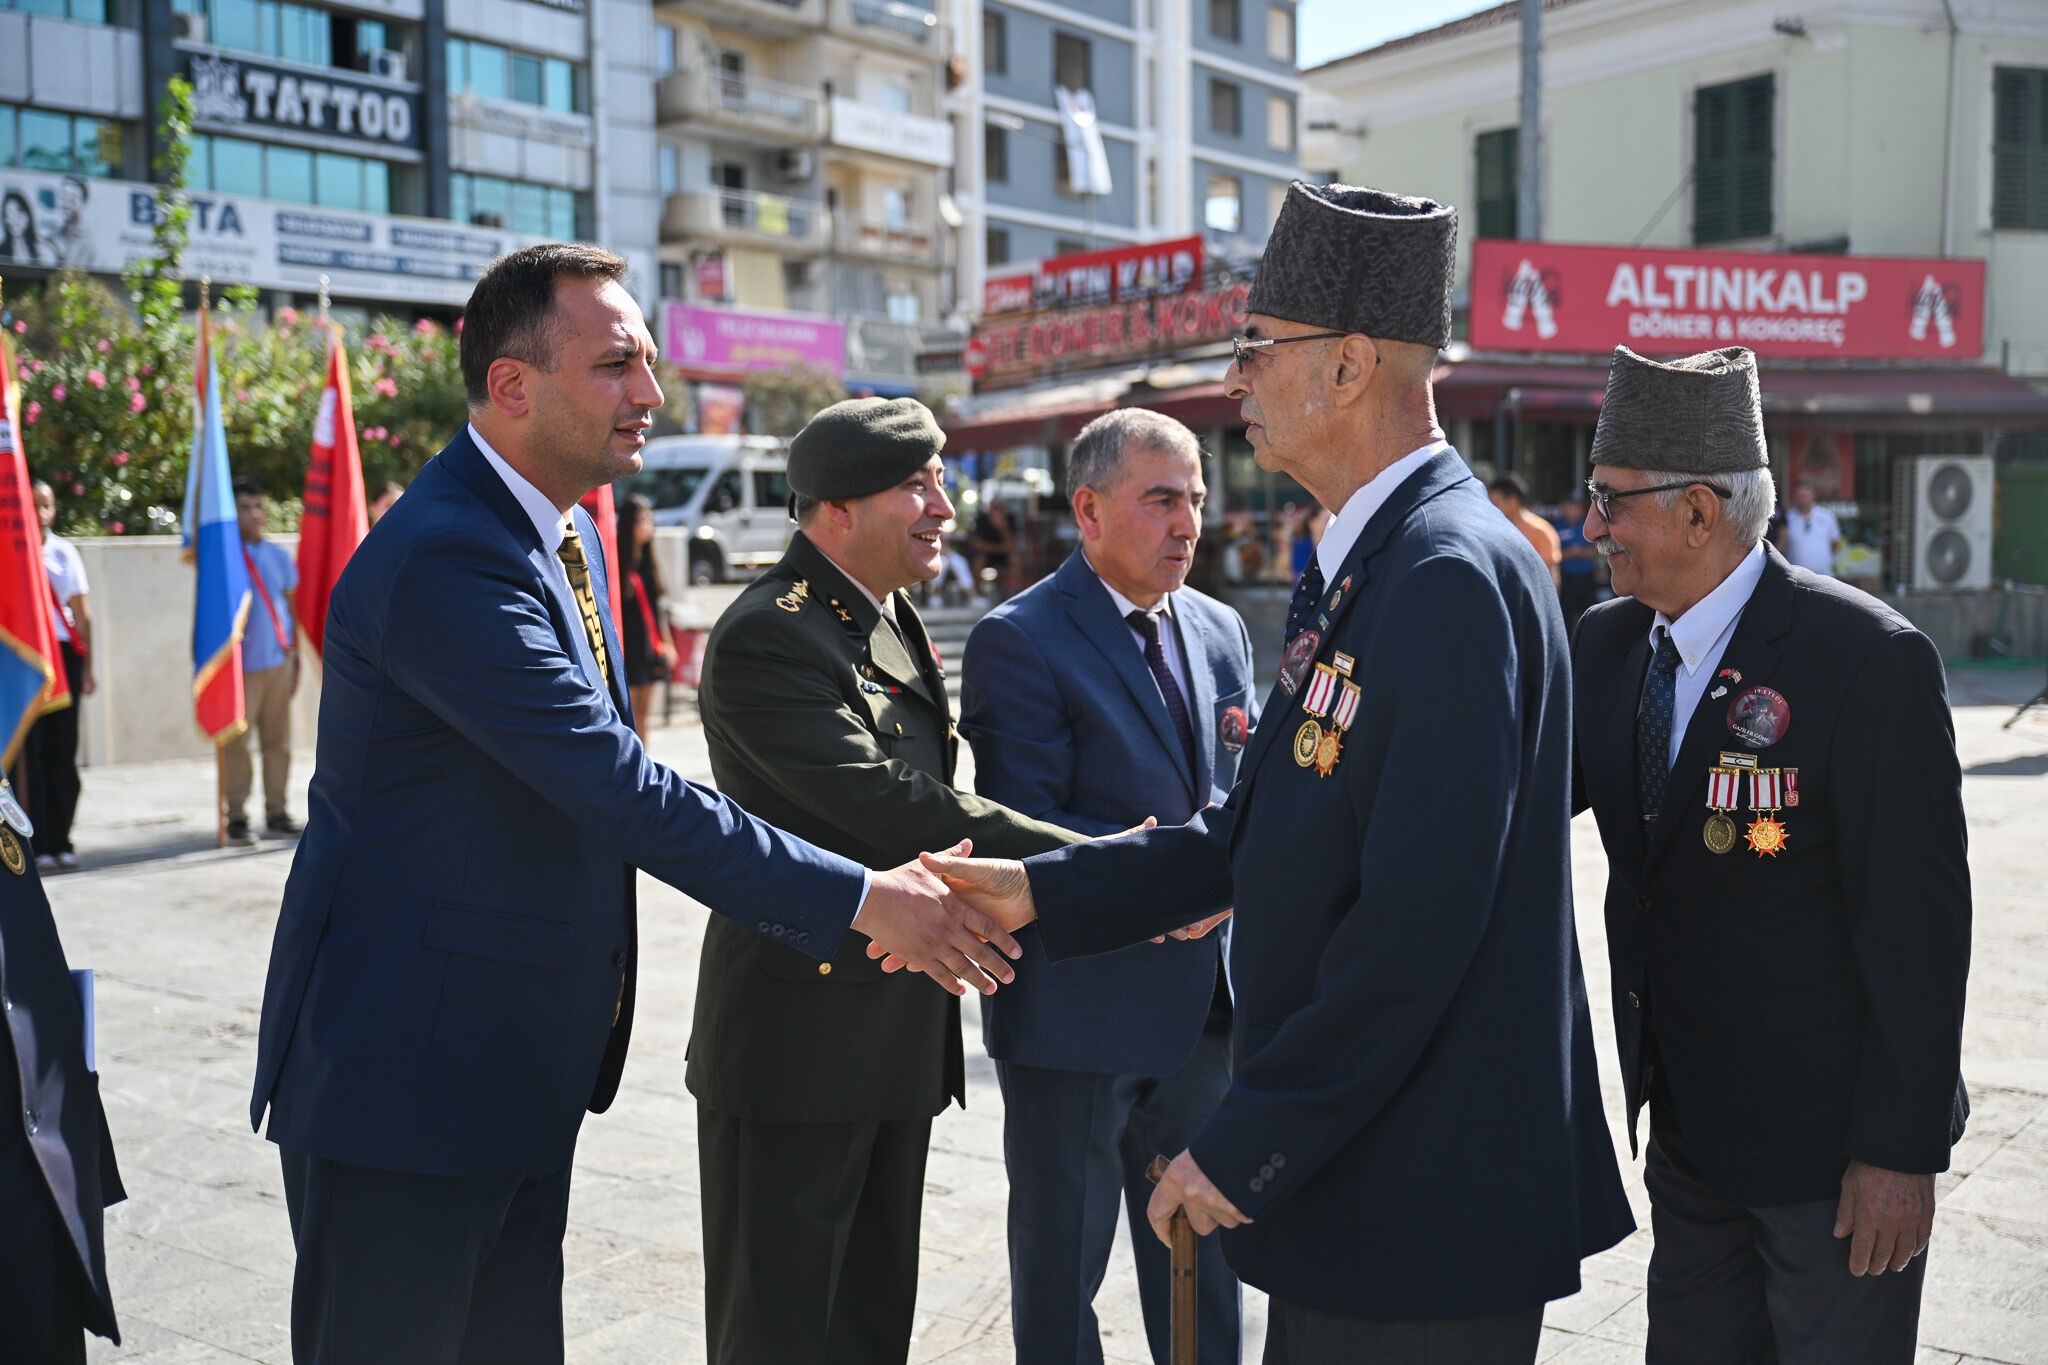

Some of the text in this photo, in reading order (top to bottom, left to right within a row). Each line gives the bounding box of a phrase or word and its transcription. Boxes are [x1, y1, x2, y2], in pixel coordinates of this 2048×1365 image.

[245, 69, 411, 142] TATTOO
[130, 192, 244, 234] BTA
[1606, 263, 1868, 314] ALTINKALP
[1628, 309, 1846, 348] DÖNER & KOKOREÇ
